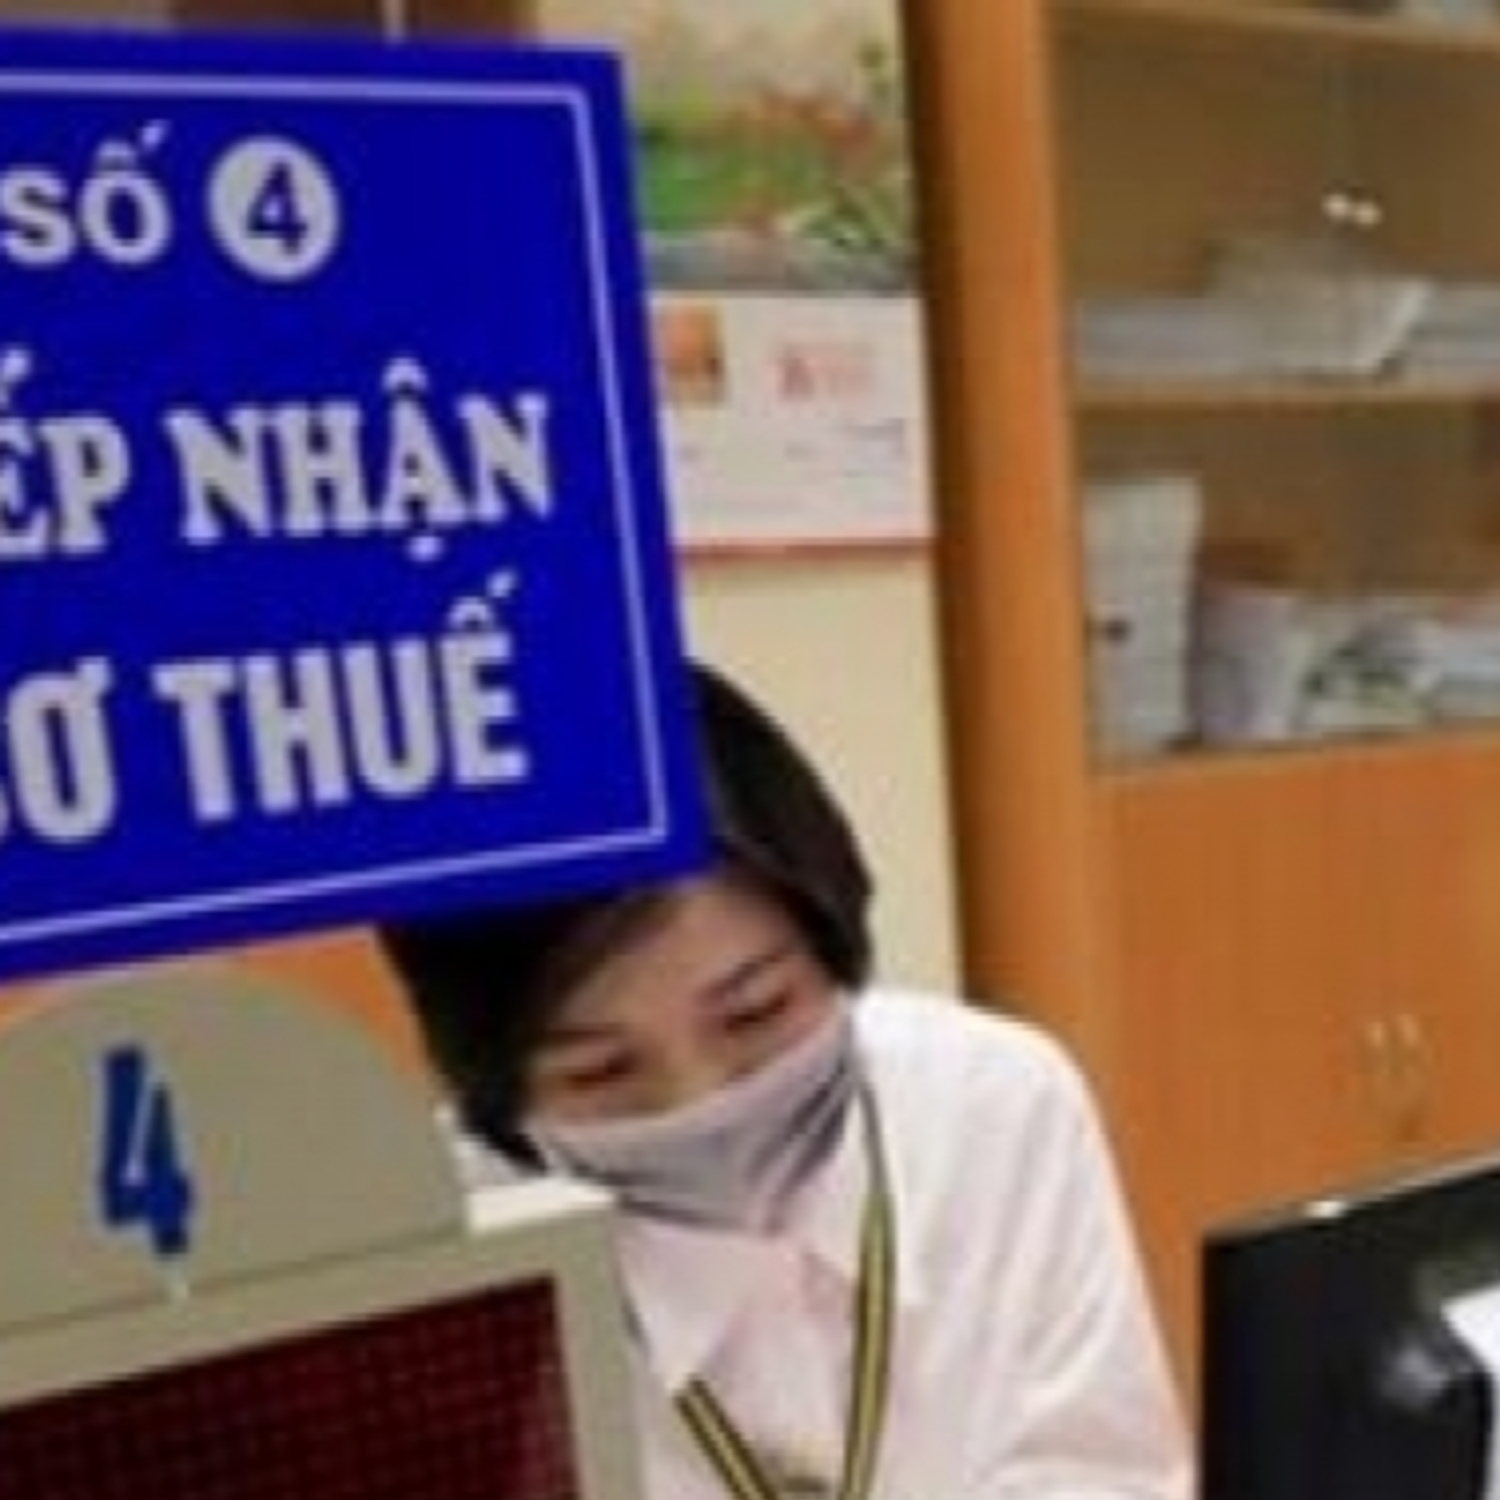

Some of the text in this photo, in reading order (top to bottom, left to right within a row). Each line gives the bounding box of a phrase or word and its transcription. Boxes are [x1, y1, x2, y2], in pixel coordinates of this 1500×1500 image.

[0, 122, 170, 264] số
[165, 356, 552, 562] NHẬN
[0, 571, 528, 844] Ơ THUẾ
[99, 1043, 195, 1259] 4
